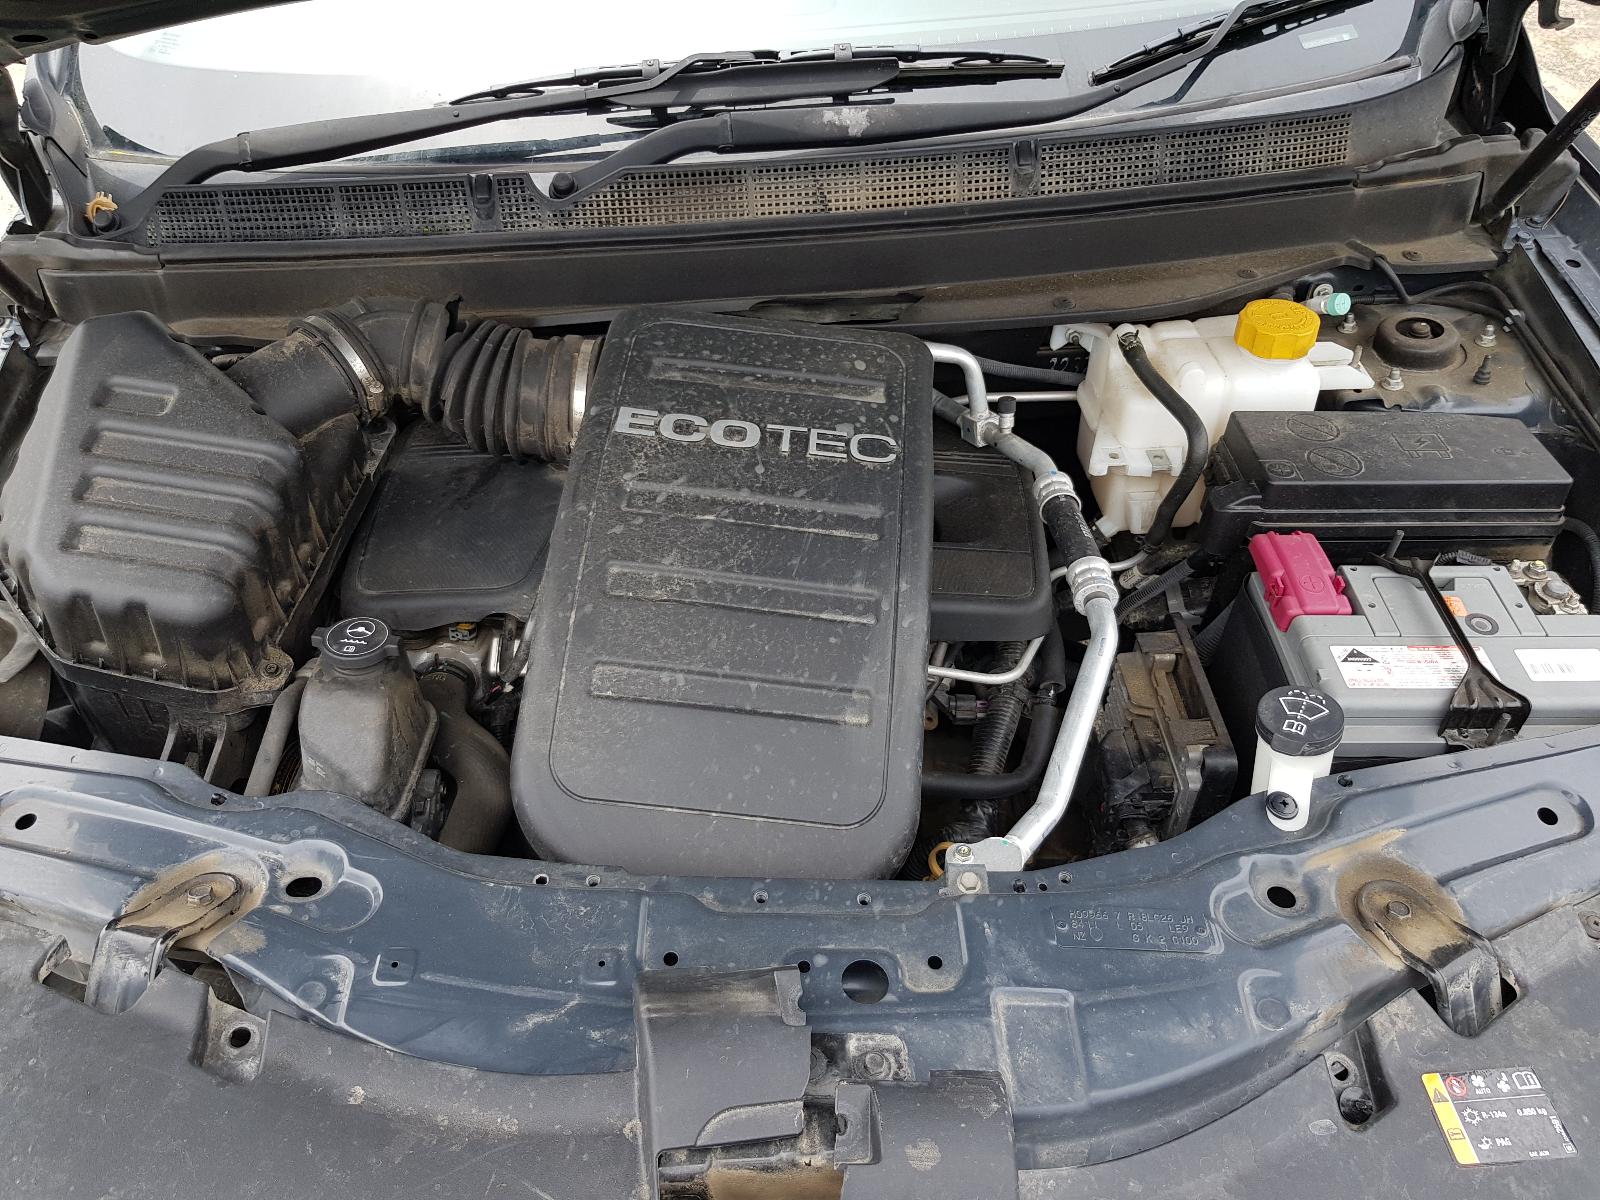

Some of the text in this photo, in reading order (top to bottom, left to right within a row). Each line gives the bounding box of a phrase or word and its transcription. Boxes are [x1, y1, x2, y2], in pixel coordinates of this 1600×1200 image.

[613, 406, 898, 463] ECOTEC
[1475, 1087, 1491, 1095] AUTO
[1495, 1136, 1512, 1147] PAG
